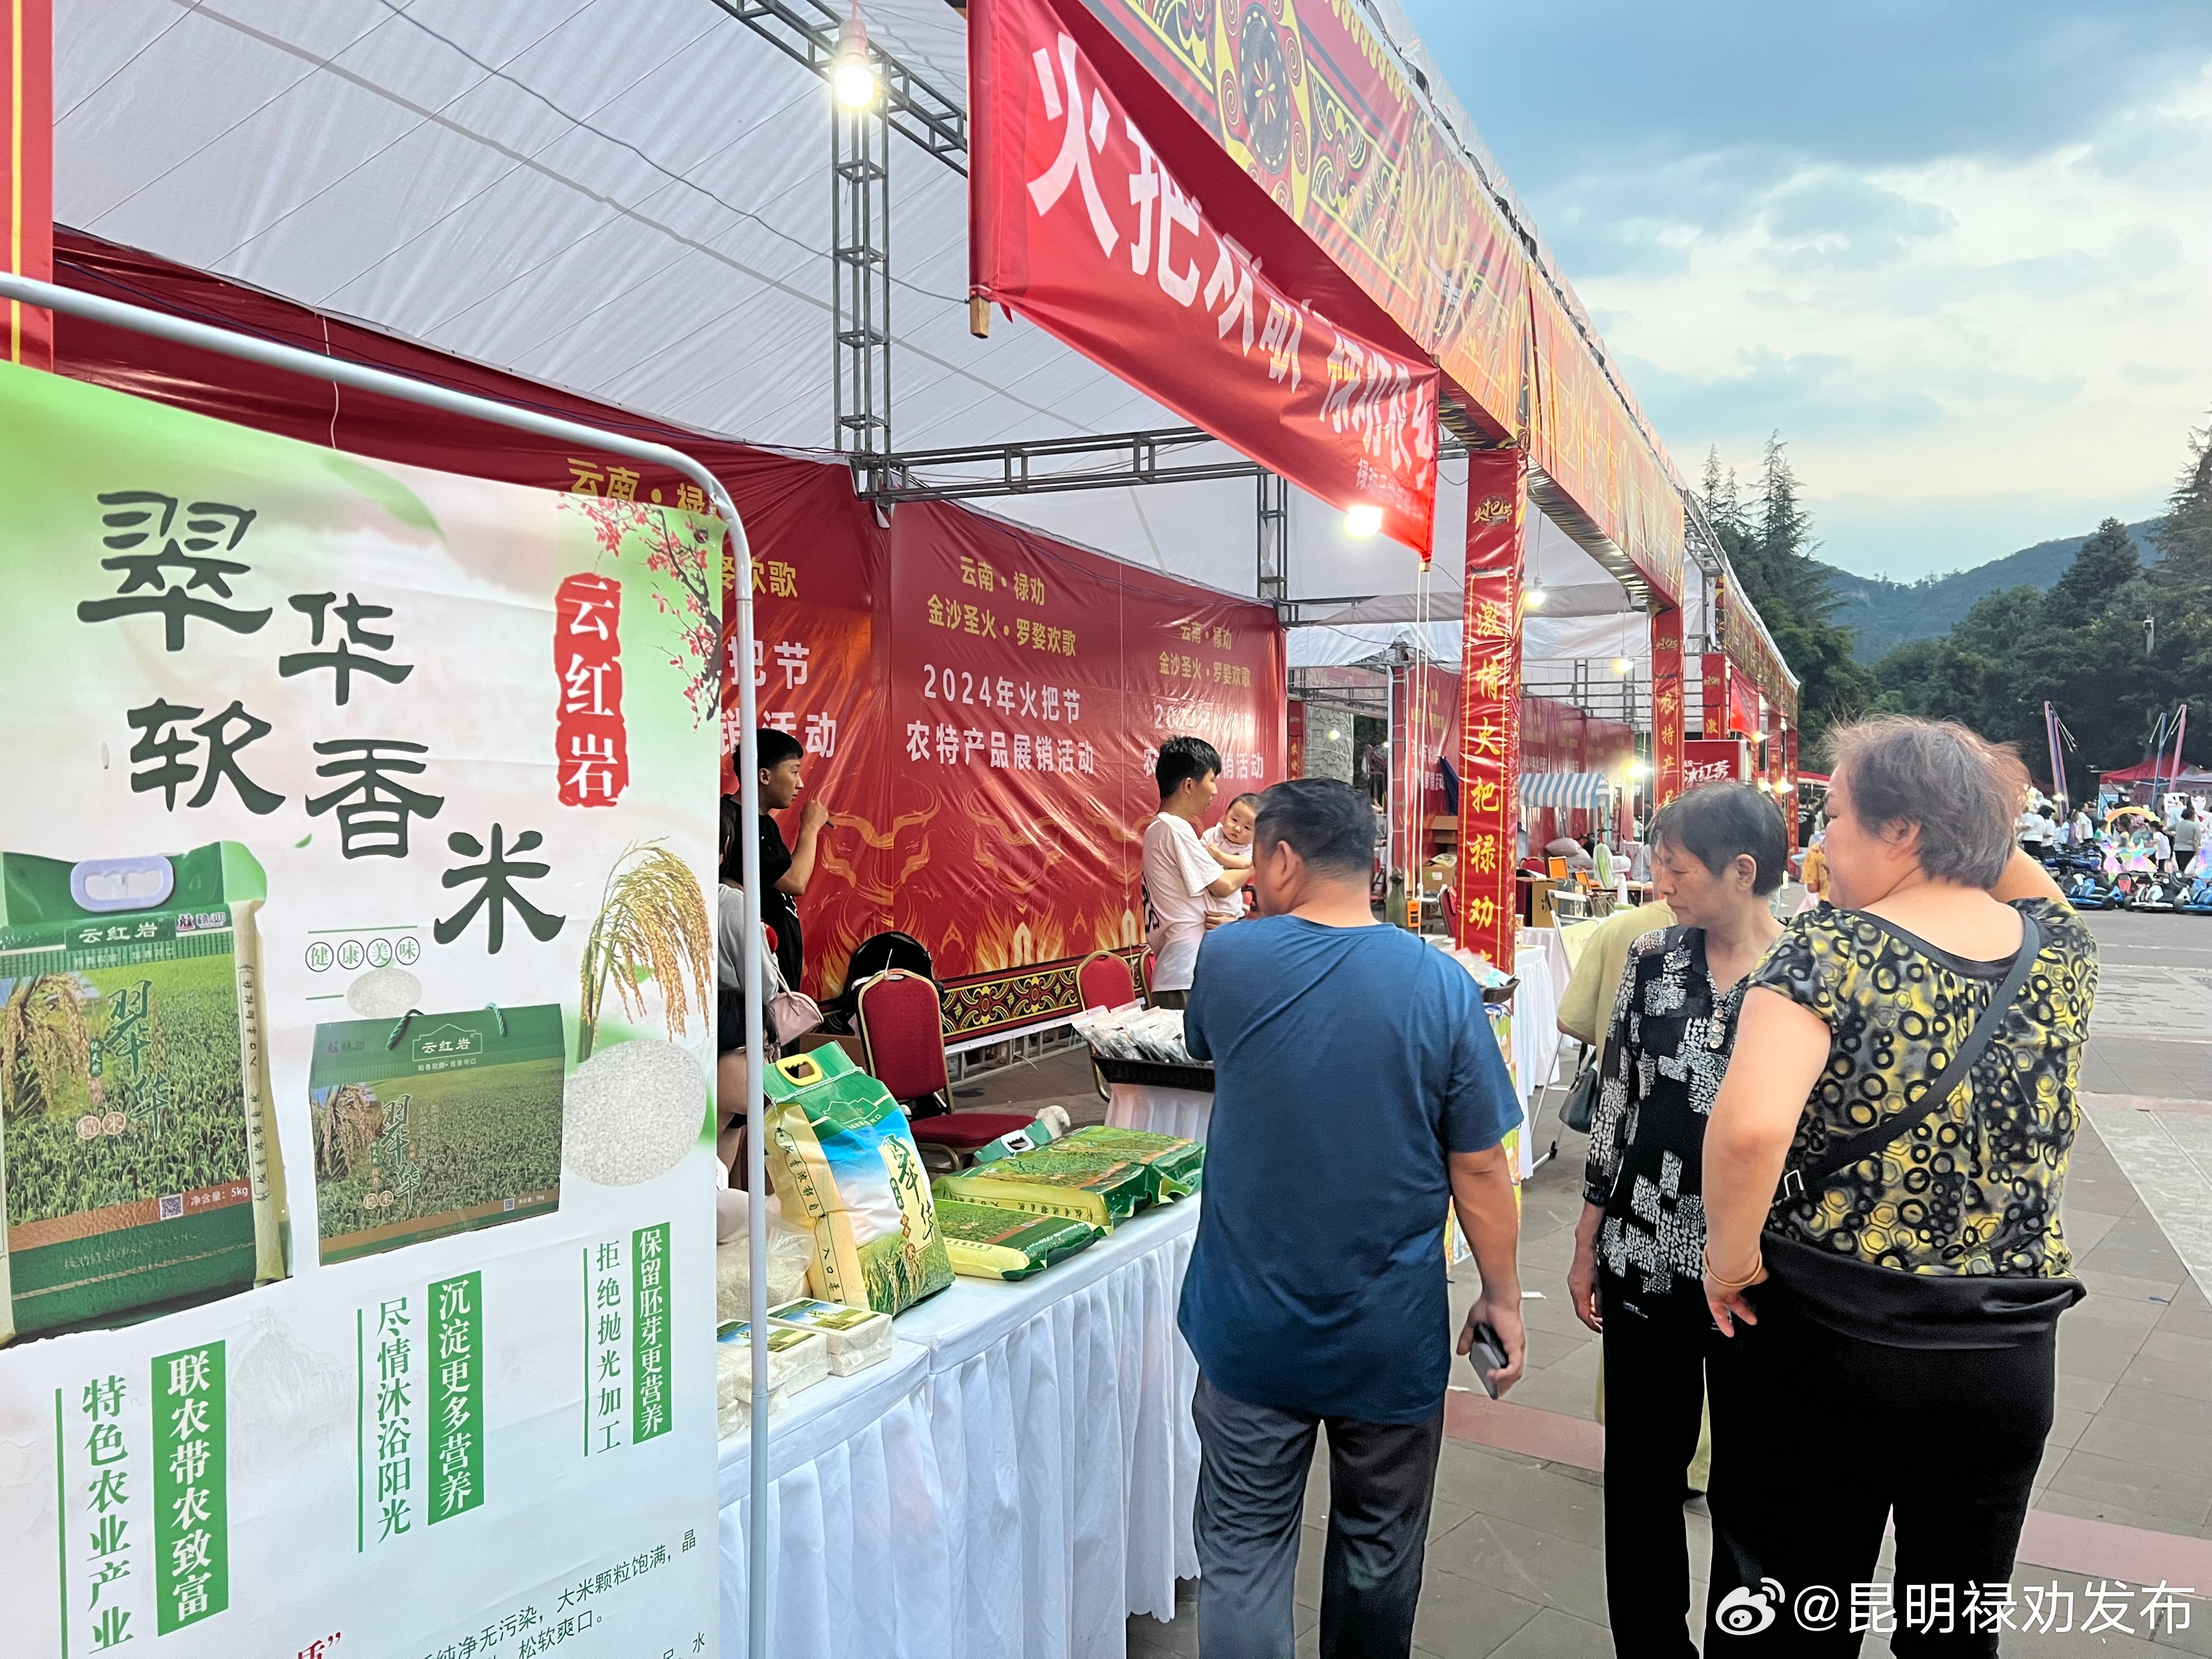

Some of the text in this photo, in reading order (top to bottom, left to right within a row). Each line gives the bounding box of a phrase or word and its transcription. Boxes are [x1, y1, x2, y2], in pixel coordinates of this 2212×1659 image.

[77, 491, 414, 706] 翠华
[927, 594, 1076, 657] 金沙圣火·罗婺欢歌
[960, 555, 1045, 606] 云南·禄劝
[563, 582, 618, 799] 云红岩
[906, 720, 1094, 774] 农特产品展销活动
[924, 664, 1080, 724] 2024年火把节
[1469, 600, 1503, 963] 激情火把禄劝
[79, 922, 158, 944] 云红岩
[127, 697, 566, 955] 软香米
[309, 940, 417, 968] 健康美味
[421, 1037, 471, 1054] 云红岩
[377, 1296, 411, 1544] 尽情沐浴阳光
[439, 1279, 472, 1516] 沉淀更多营养
[596, 1239, 621, 1454] 拒绝抛光加工
[639, 1229, 663, 1437] 保留胚芽更营养
[82, 1375, 134, 1654] 特色农业产业
[167, 1351, 212, 1622] 联农带农致富
